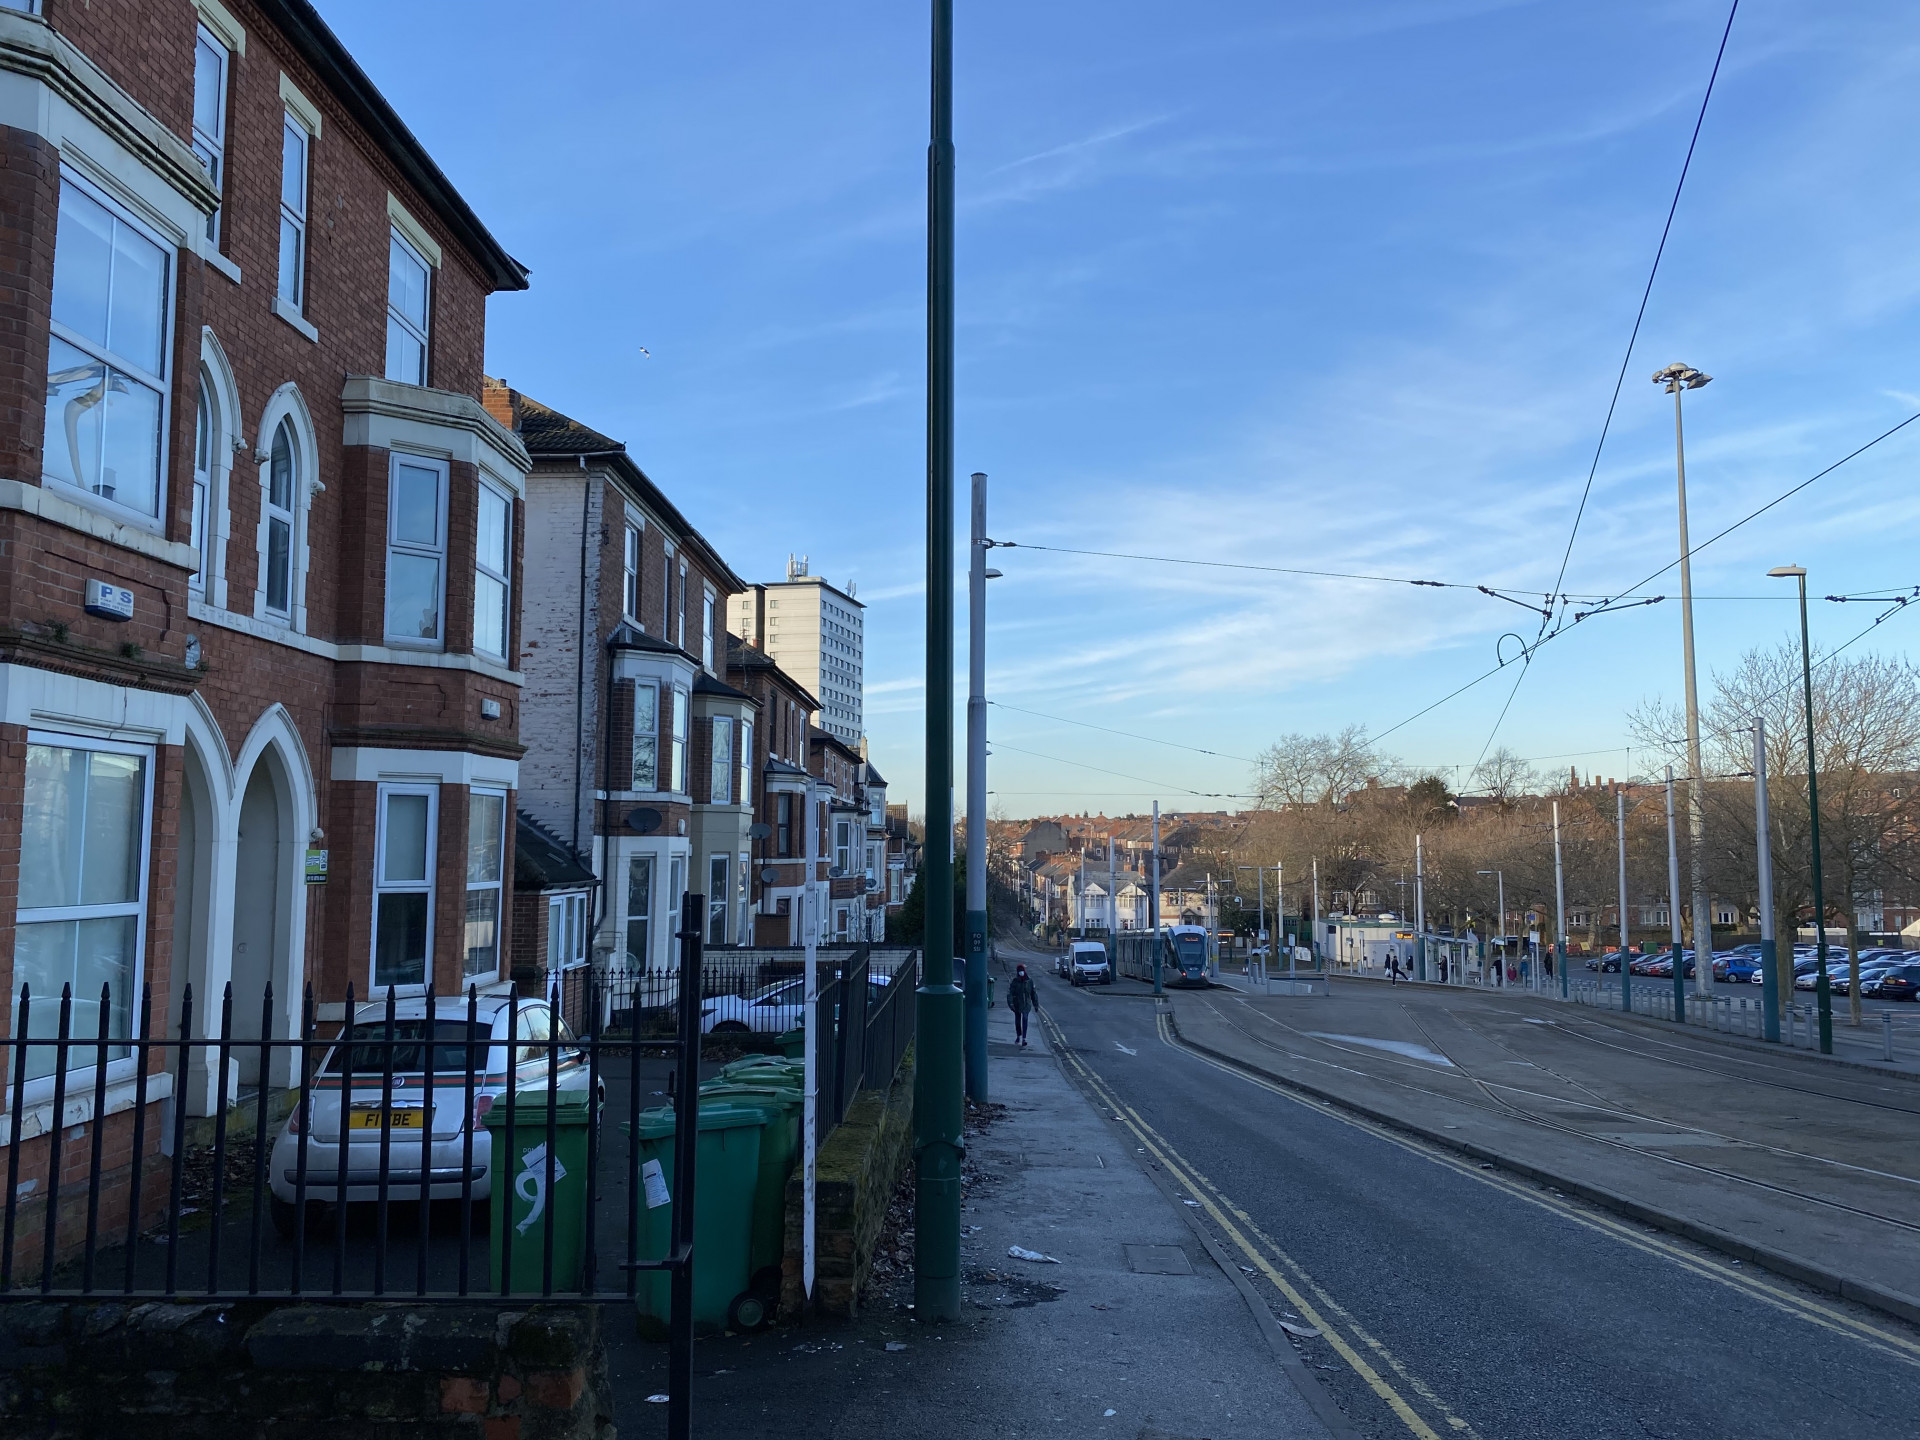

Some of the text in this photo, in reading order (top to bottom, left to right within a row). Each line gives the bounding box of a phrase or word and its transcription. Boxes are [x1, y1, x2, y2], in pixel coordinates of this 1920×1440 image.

[101, 585, 113, 598] P
[120, 591, 132, 604] S
[199, 604, 242, 628] ETHEL
[515, 1168, 546, 1236] 9
